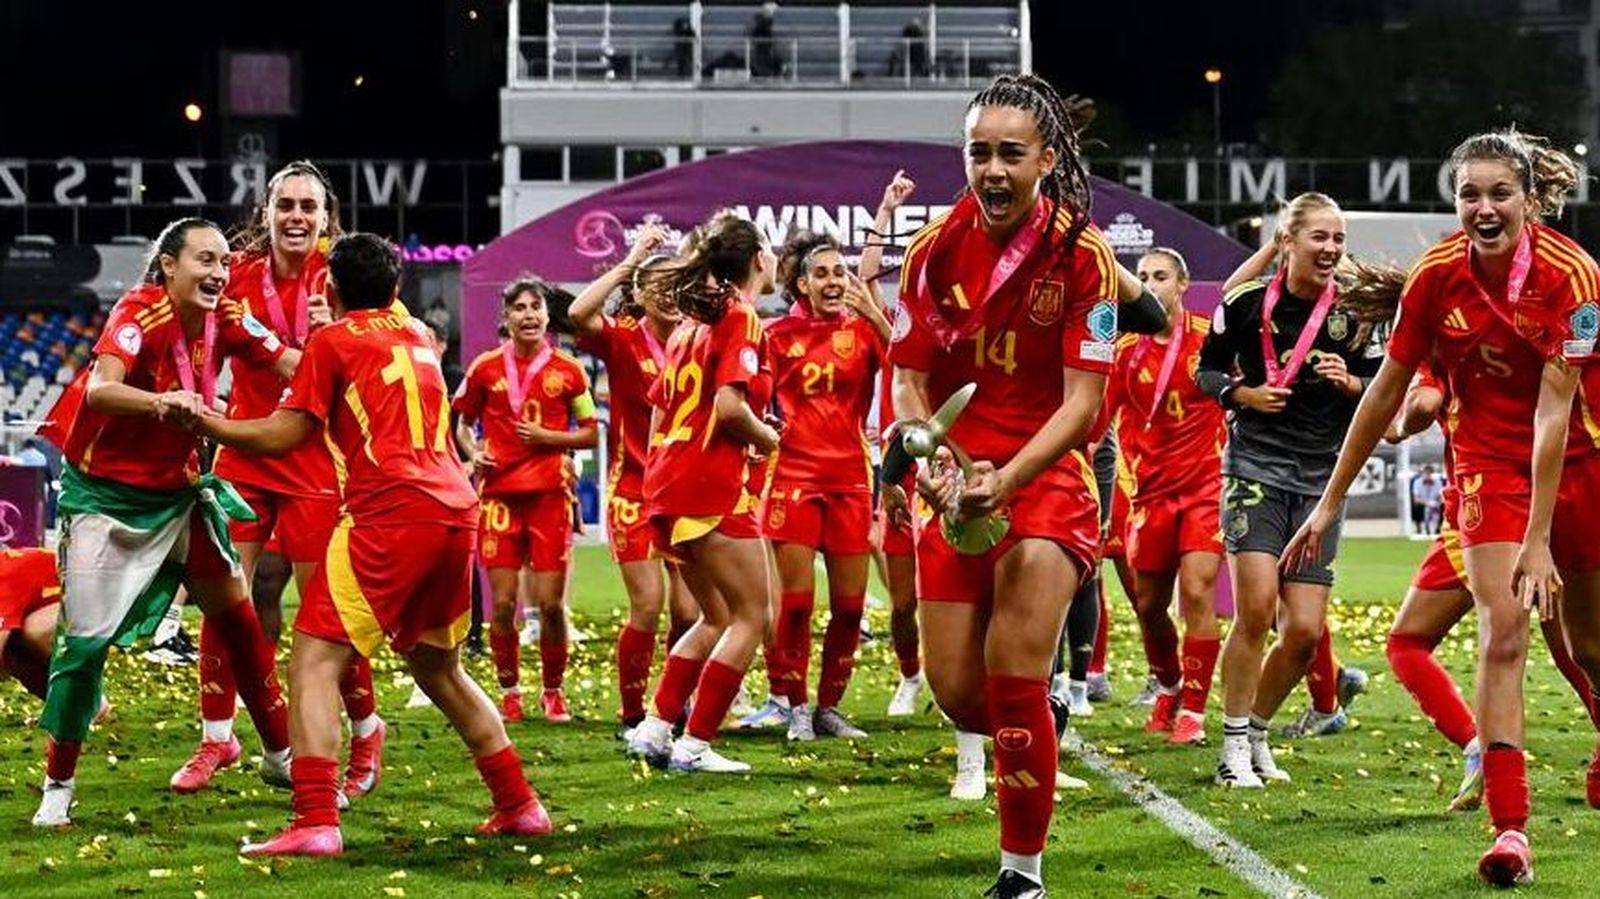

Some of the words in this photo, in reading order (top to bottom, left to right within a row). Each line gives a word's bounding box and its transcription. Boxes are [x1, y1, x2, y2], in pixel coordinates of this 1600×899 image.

[735, 205, 955, 247] WINNE
[970, 327, 1017, 376] 14
[1479, 343, 1513, 378] 5
[802, 361, 834, 394] 21
[381, 345, 450, 453] 17
[1165, 391, 1185, 424] 4
[483, 500, 509, 532] 10
